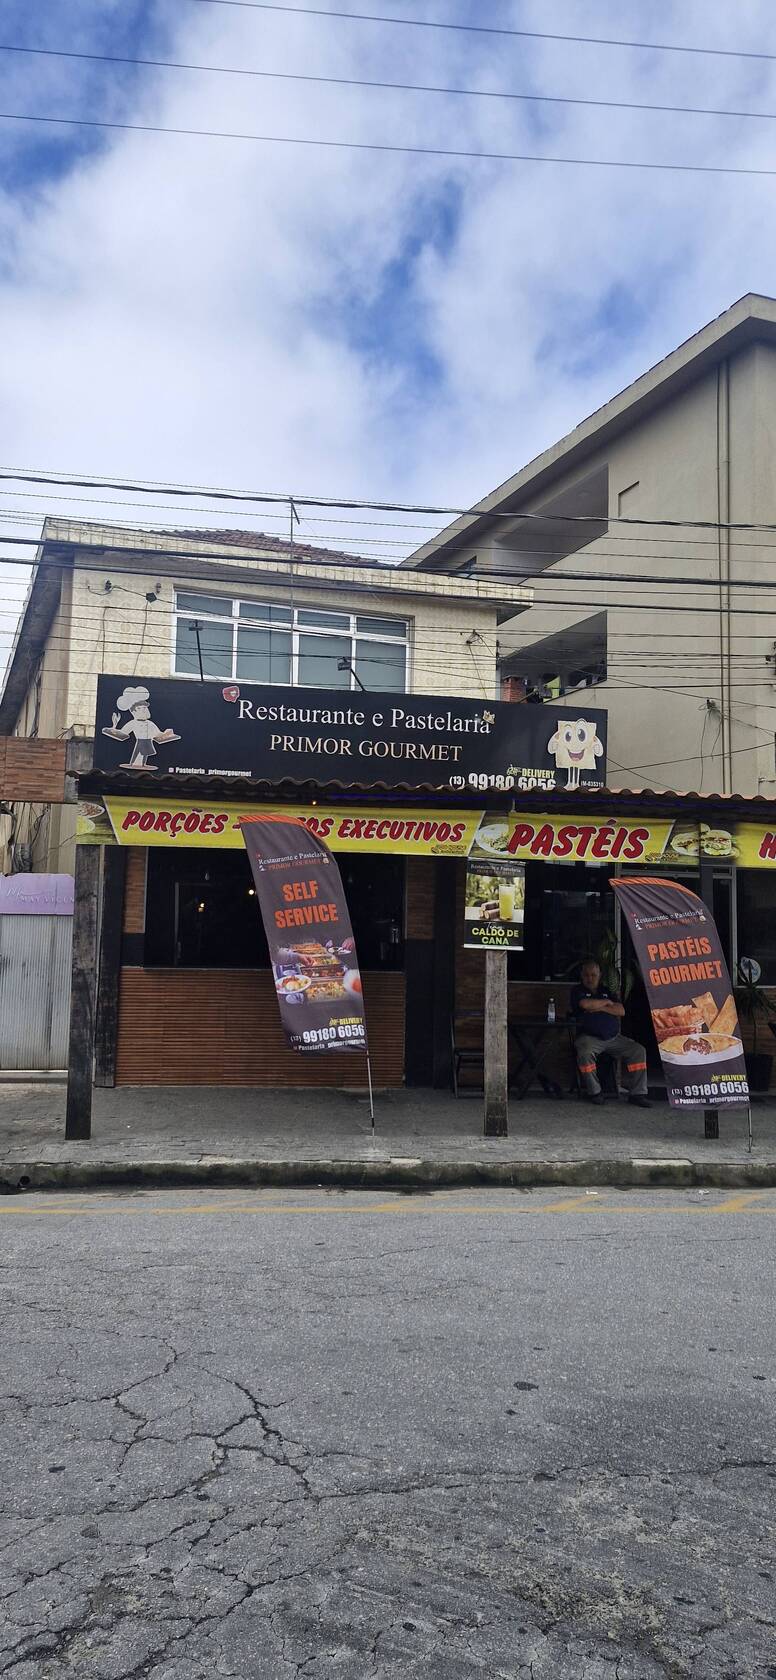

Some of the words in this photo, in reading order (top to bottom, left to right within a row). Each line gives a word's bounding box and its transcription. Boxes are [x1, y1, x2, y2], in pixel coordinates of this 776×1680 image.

[237, 699, 365, 726] Restaurante
[372, 712, 384, 727] e
[390, 708, 491, 734] Pastelaria
[269, 734, 353, 756] PRIMOR
[358, 740, 463, 762] GOURMET
[449, 775, 466, 787] (13)
[468, 772, 515, 791] 99180
[521, 767, 556, 779] DELIVERY
[121, 807, 229, 838] PORÇÕES
[337, 818, 466, 843] EXECUTIVOS
[506, 818, 650, 859] PASTÉIS
[282, 879, 319, 902] SELF
[274, 903, 339, 928] SERVICE
[471, 927, 505, 937] CALDO
[506, 929, 520, 938] DE
[481, 936, 510, 945] CANA
[647, 936, 712, 962] PASTÉIS
[649, 960, 723, 987] GOURMET
[302, 1026, 337, 1043] 99180
[337, 1024, 365, 1038] 6056
[683, 1083, 719, 1097] 99180
[719, 1081, 750, 1094] 6056
[721, 1074, 746, 1082] DELIVERY
